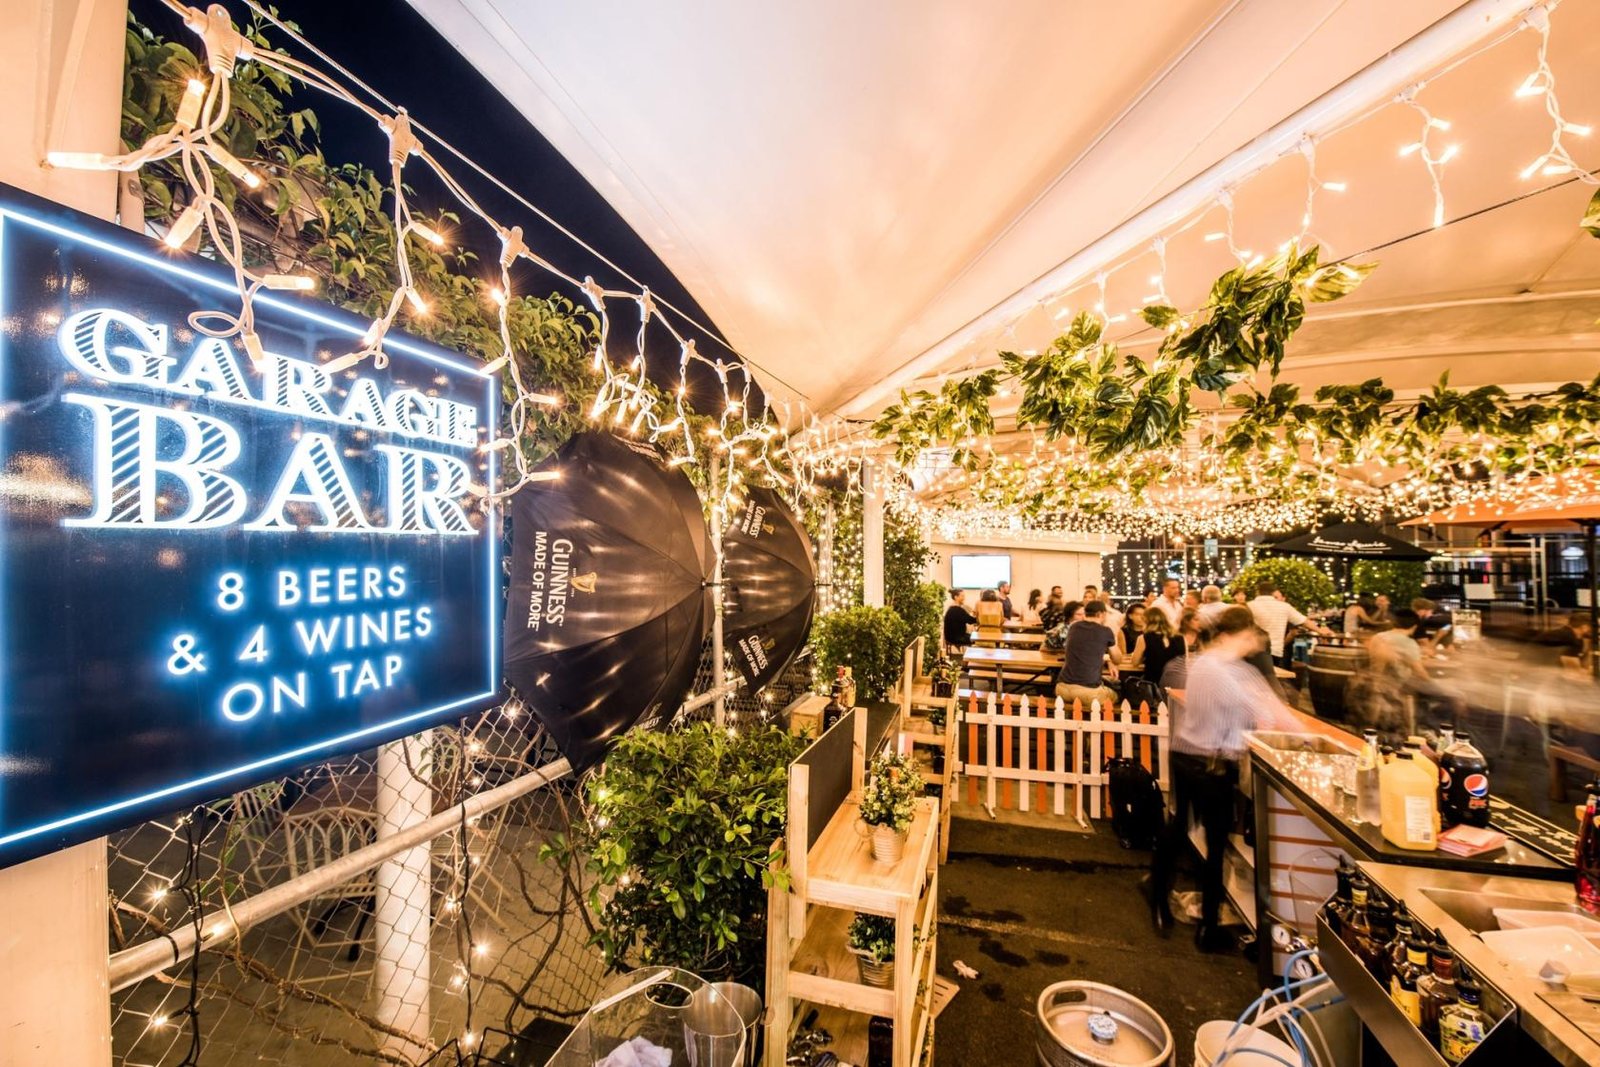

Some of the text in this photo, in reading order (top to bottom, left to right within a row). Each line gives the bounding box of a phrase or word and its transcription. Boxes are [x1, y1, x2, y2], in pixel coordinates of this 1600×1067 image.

[58, 308, 478, 448] GARAGE
[61, 392, 479, 536] BAR
[749, 506, 766, 538] GUINNESS
[216, 565, 407, 612] 8 BEERS
[527, 531, 547, 632] MADE OF MORE
[545, 538, 574, 625] GUINNESS
[166, 606, 433, 676] & 4 WINES
[748, 635, 769, 669] GUINNESS
[221, 655, 403, 722] ON TAP
